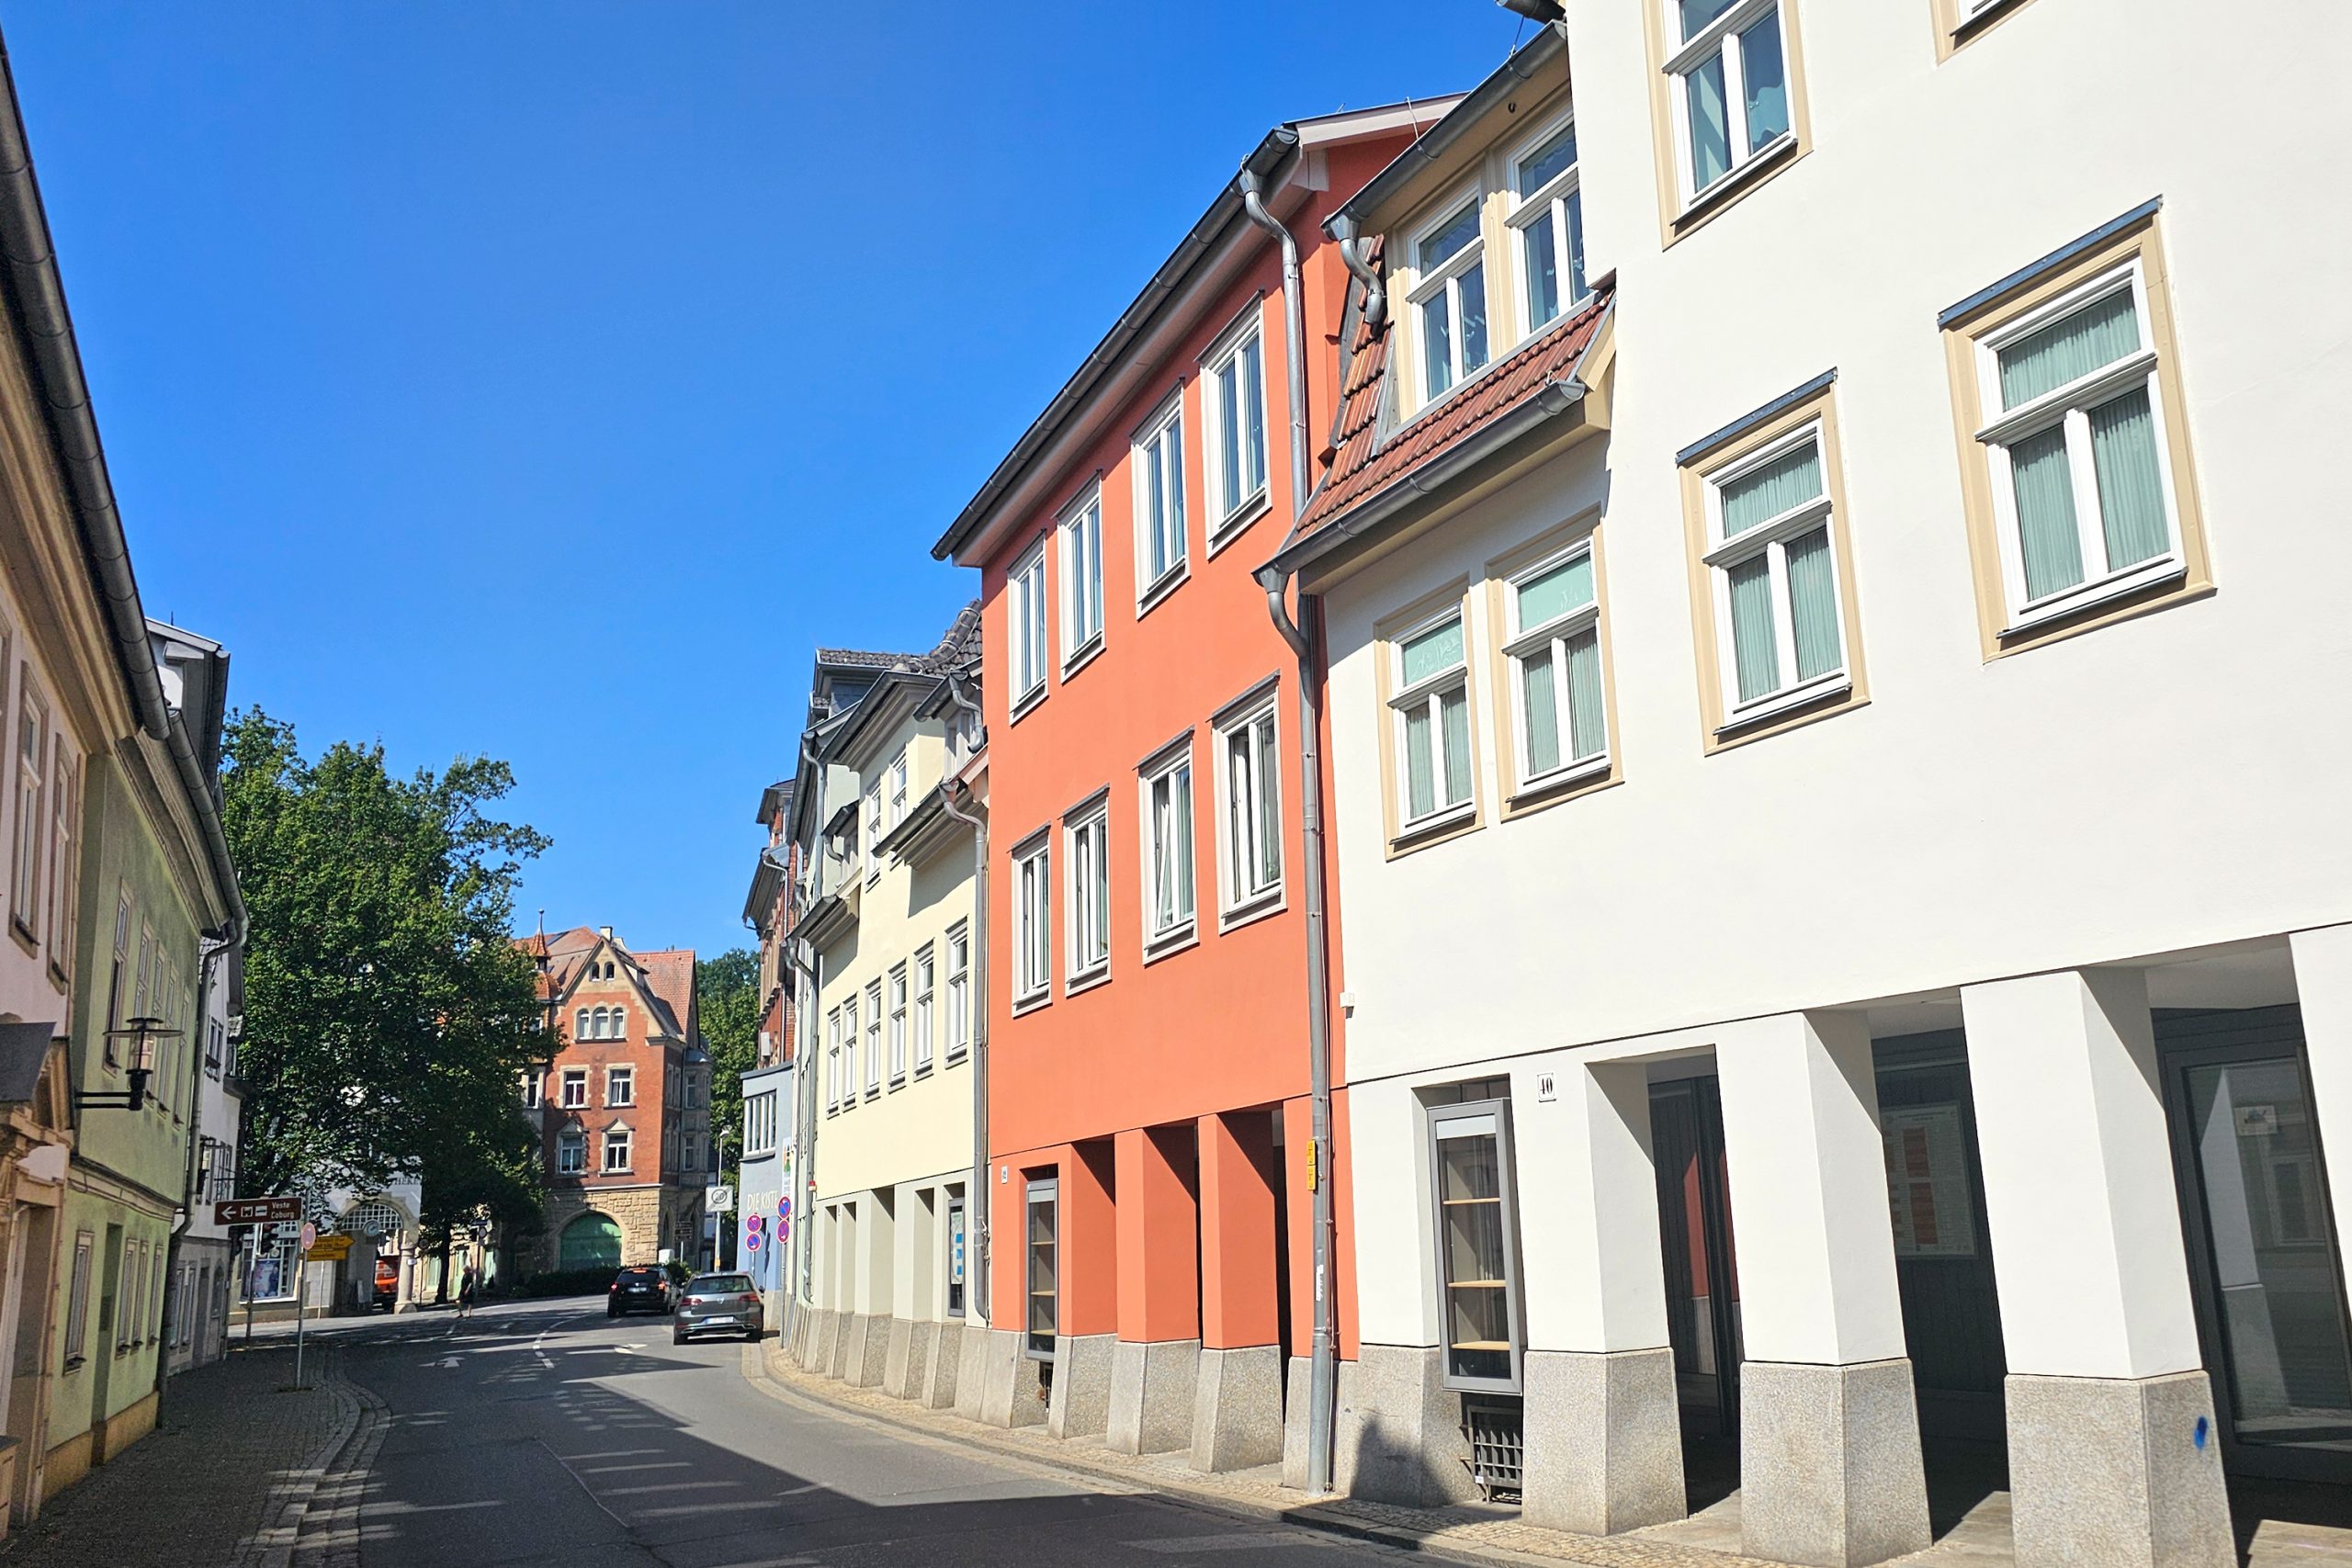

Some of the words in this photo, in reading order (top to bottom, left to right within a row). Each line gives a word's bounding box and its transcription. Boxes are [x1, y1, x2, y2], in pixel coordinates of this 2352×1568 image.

[1539, 1077, 1553, 1094] 40
[747, 1193, 759, 1212] DIE
[761, 1190, 779, 1210] KISTE
[271, 1212, 295, 1220] Coburg
